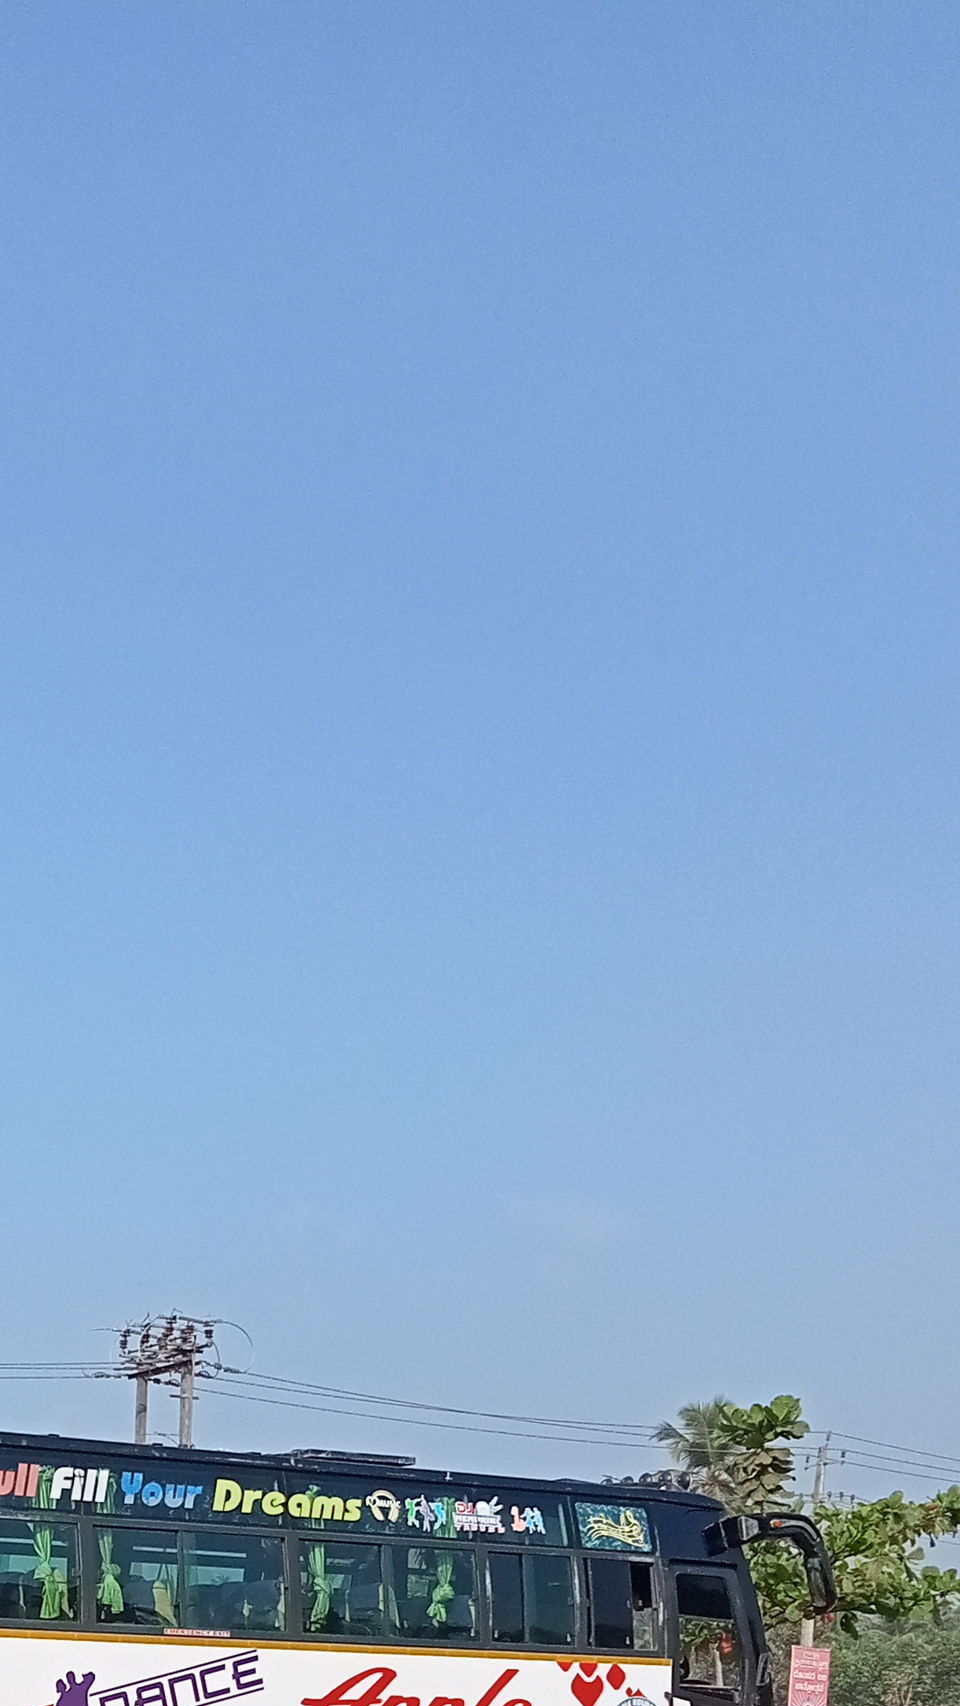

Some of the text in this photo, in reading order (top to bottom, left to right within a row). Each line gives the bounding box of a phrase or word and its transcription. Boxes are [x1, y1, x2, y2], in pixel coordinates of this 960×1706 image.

[50, 1466, 110, 1503] Fill
[120, 1471, 204, 1508] Your
[212, 1478, 363, 1523] Dreams
